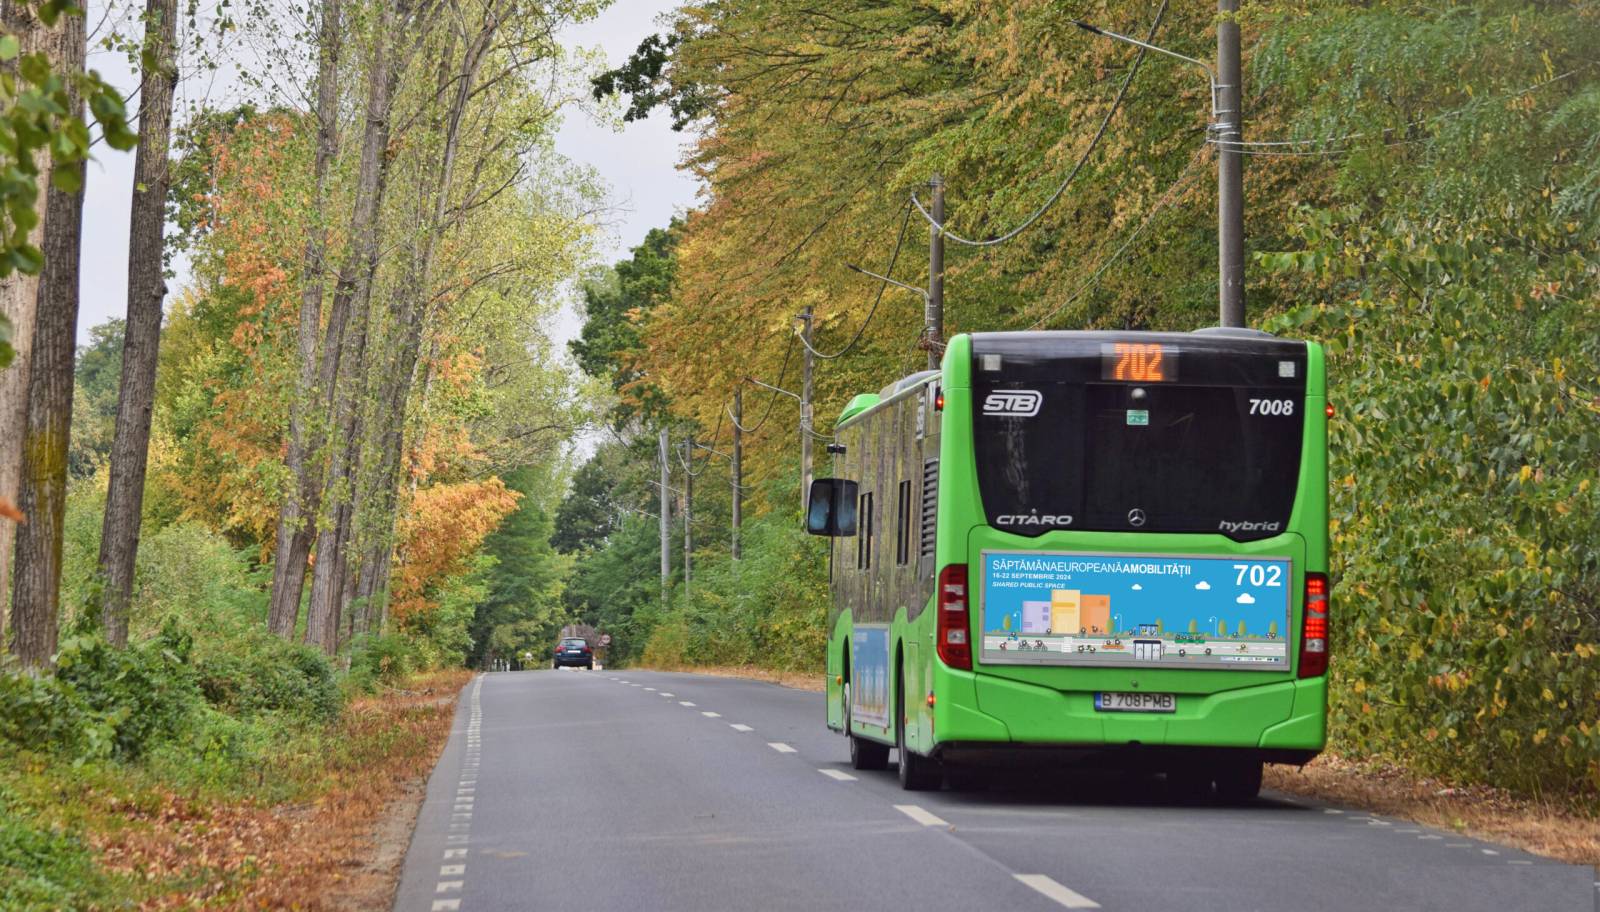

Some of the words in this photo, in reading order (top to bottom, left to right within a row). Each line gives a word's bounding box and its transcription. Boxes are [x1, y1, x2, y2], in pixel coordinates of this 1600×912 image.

[1114, 344, 1163, 381] 702
[983, 392, 1039, 413] STB
[1249, 399, 1294, 415] 7008
[1219, 520, 1280, 532] hybrid
[1011, 572, 1055, 580] SEPTEMBRIE
[1233, 564, 1282, 587] 702
[1102, 693, 1112, 706] B
